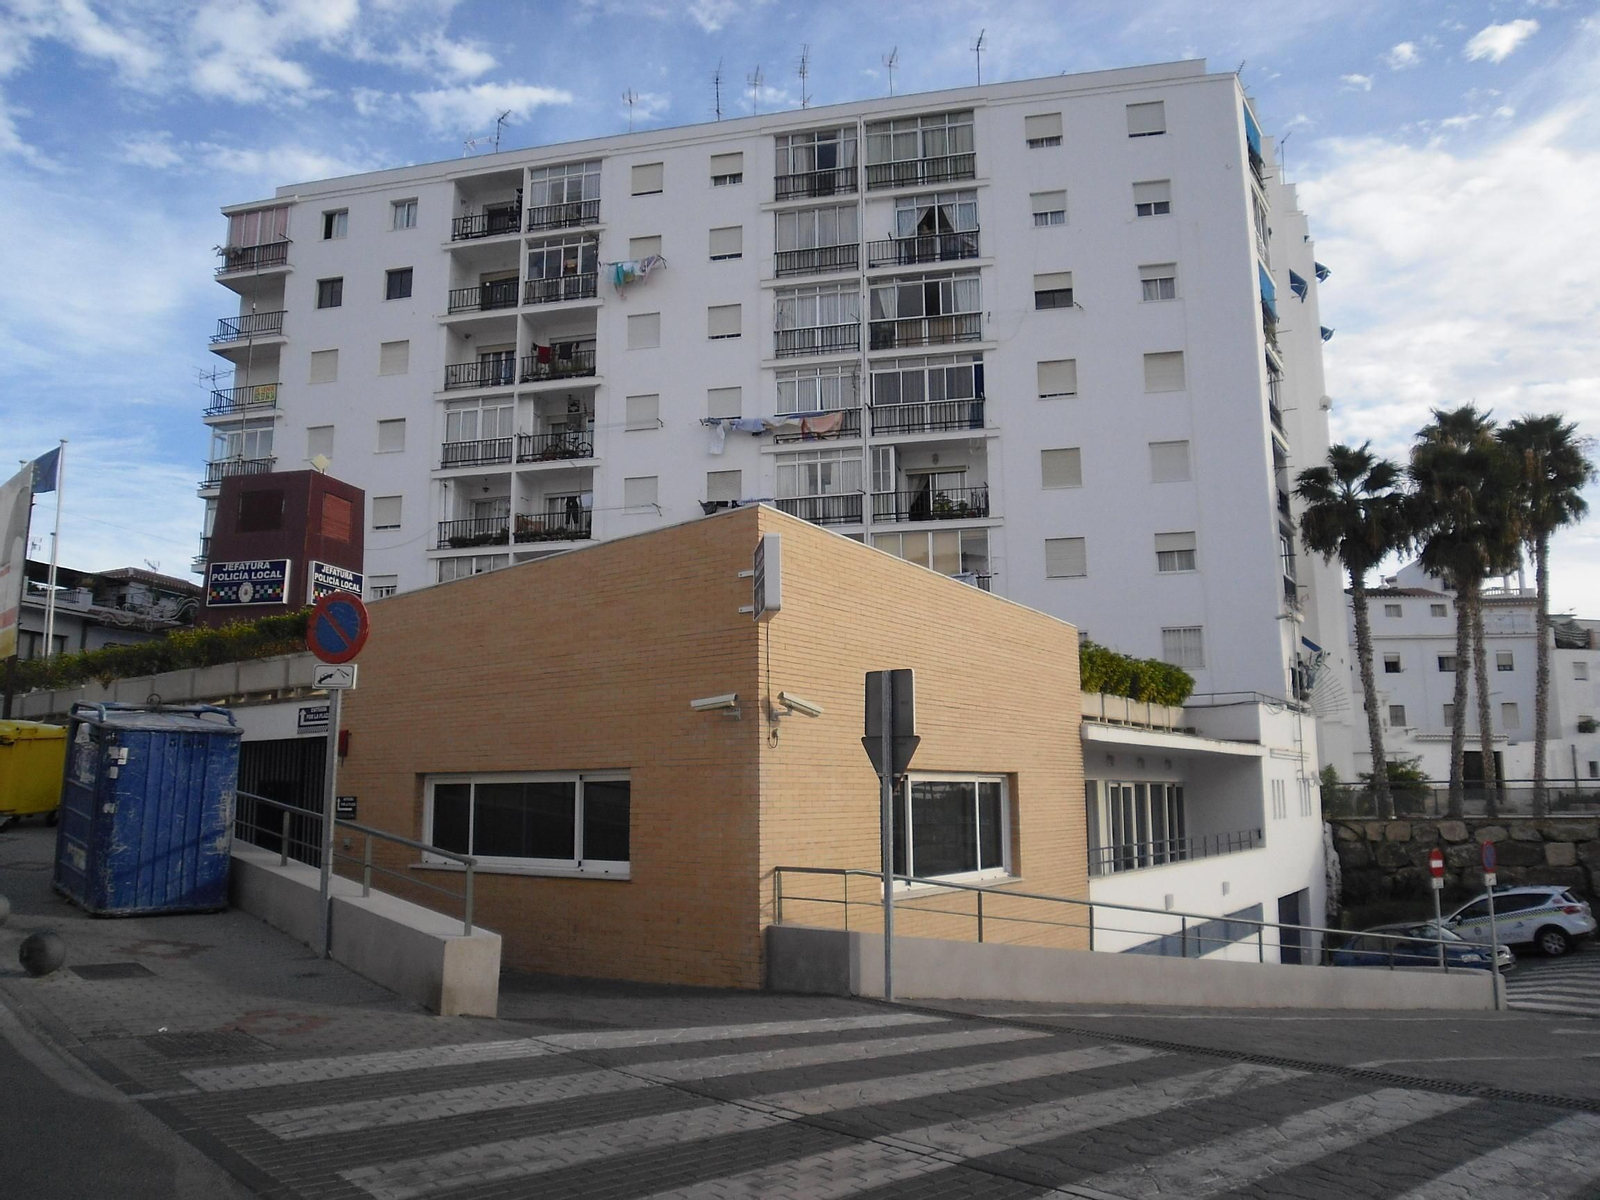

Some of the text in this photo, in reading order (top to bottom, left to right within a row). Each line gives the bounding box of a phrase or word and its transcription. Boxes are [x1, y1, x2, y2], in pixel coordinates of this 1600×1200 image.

[222, 562, 270, 571] JEFATURA
[212, 570, 282, 581] POLICÍA LOCAL
[321, 565, 353, 581] JEFATURA
[340, 580, 361, 592] LOCAL
